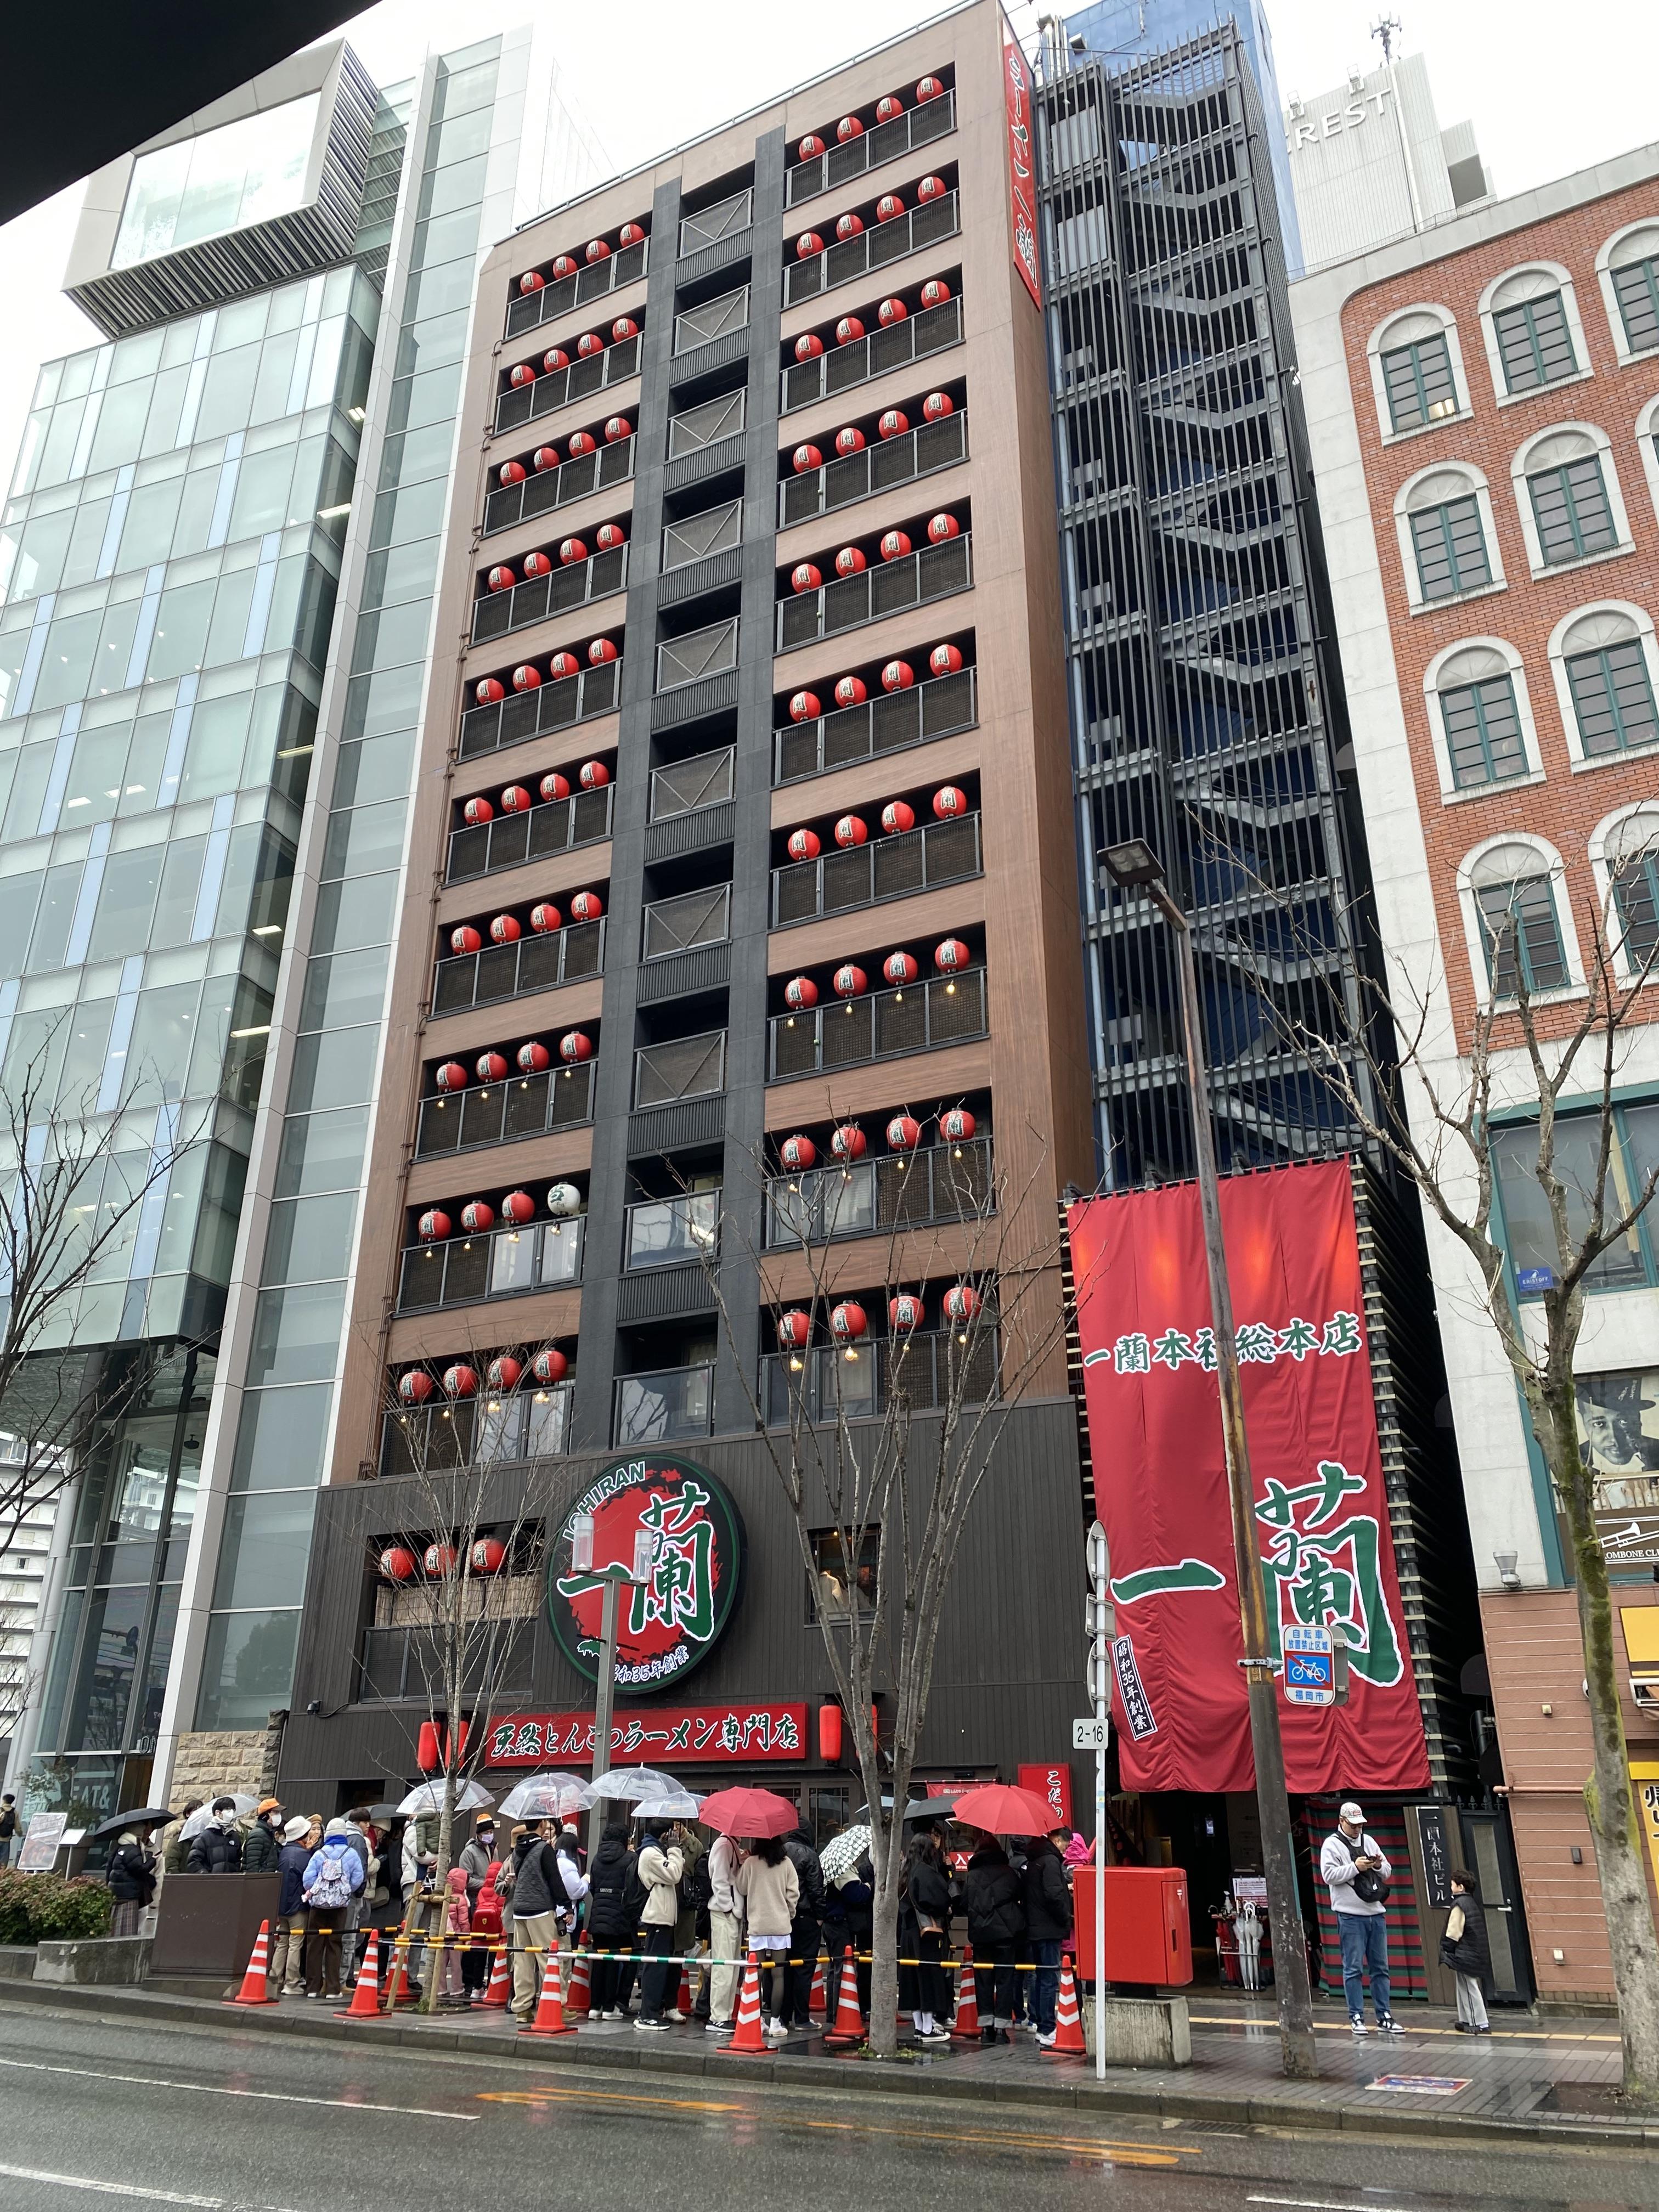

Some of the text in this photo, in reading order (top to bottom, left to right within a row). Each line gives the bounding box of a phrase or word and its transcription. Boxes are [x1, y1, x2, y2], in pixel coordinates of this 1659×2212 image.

[1285, 88, 1391, 153] REST
[556, 1481, 714, 1641] 一蘭
[1110, 1460, 1404, 1688] 一蘭
[1293, 1629, 1323, 1639] 自転車
[1288, 1639, 1328, 1651] 放置禁止区域
[1118, 1642, 1148, 1730] 昭和35年創業
[1295, 1690, 1324, 1702] 福岡市
[1077, 1725, 1103, 1743] 2-16
[955, 1853, 974, 1865] 入
